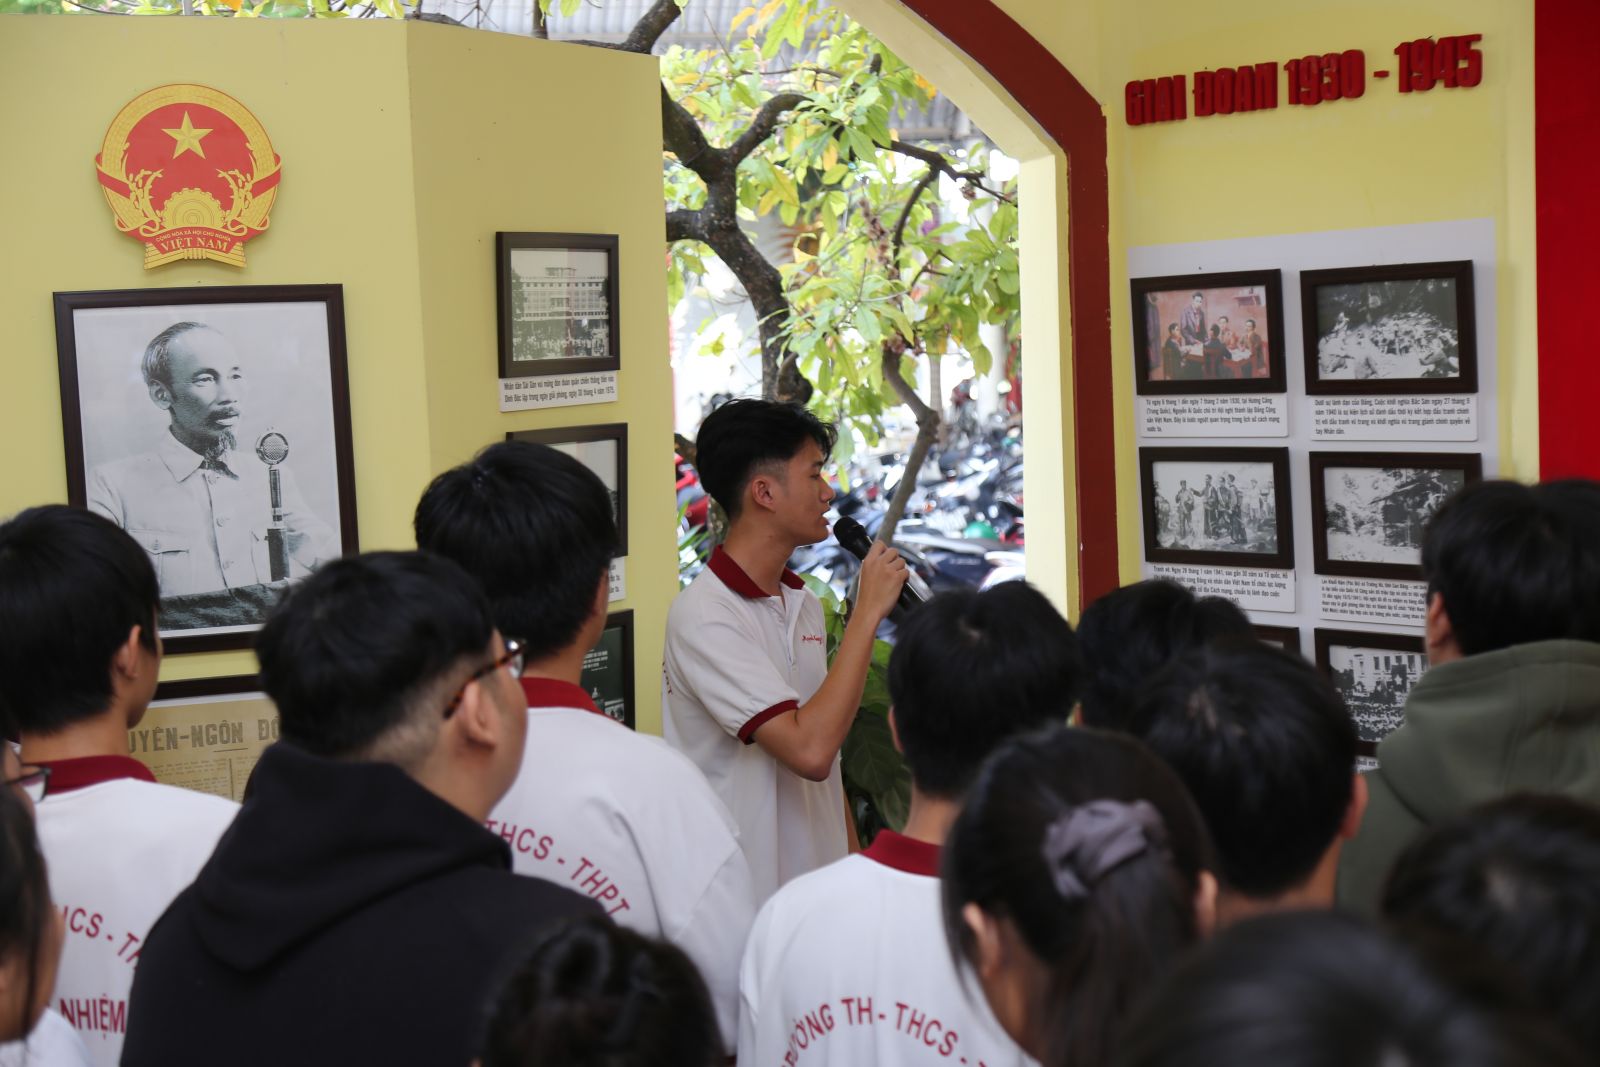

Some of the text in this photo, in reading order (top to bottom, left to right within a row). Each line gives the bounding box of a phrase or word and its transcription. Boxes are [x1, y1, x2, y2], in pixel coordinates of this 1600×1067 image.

[1125, 75, 1187, 126] GIAI
[1283, 49, 1365, 106] 1930
[1394, 33, 1482, 93] 1945
[161, 236, 228, 252] VIỆT NAM
[128, 719, 244, 753] UYÊN-NGÔN
[485, 819, 554, 861] THCS
[571, 857, 631, 917] THPT
[780, 1003, 835, 1067] RƯỜNG
[840, 996, 874, 1026] TH
[895, 1001, 958, 1057] THCS
